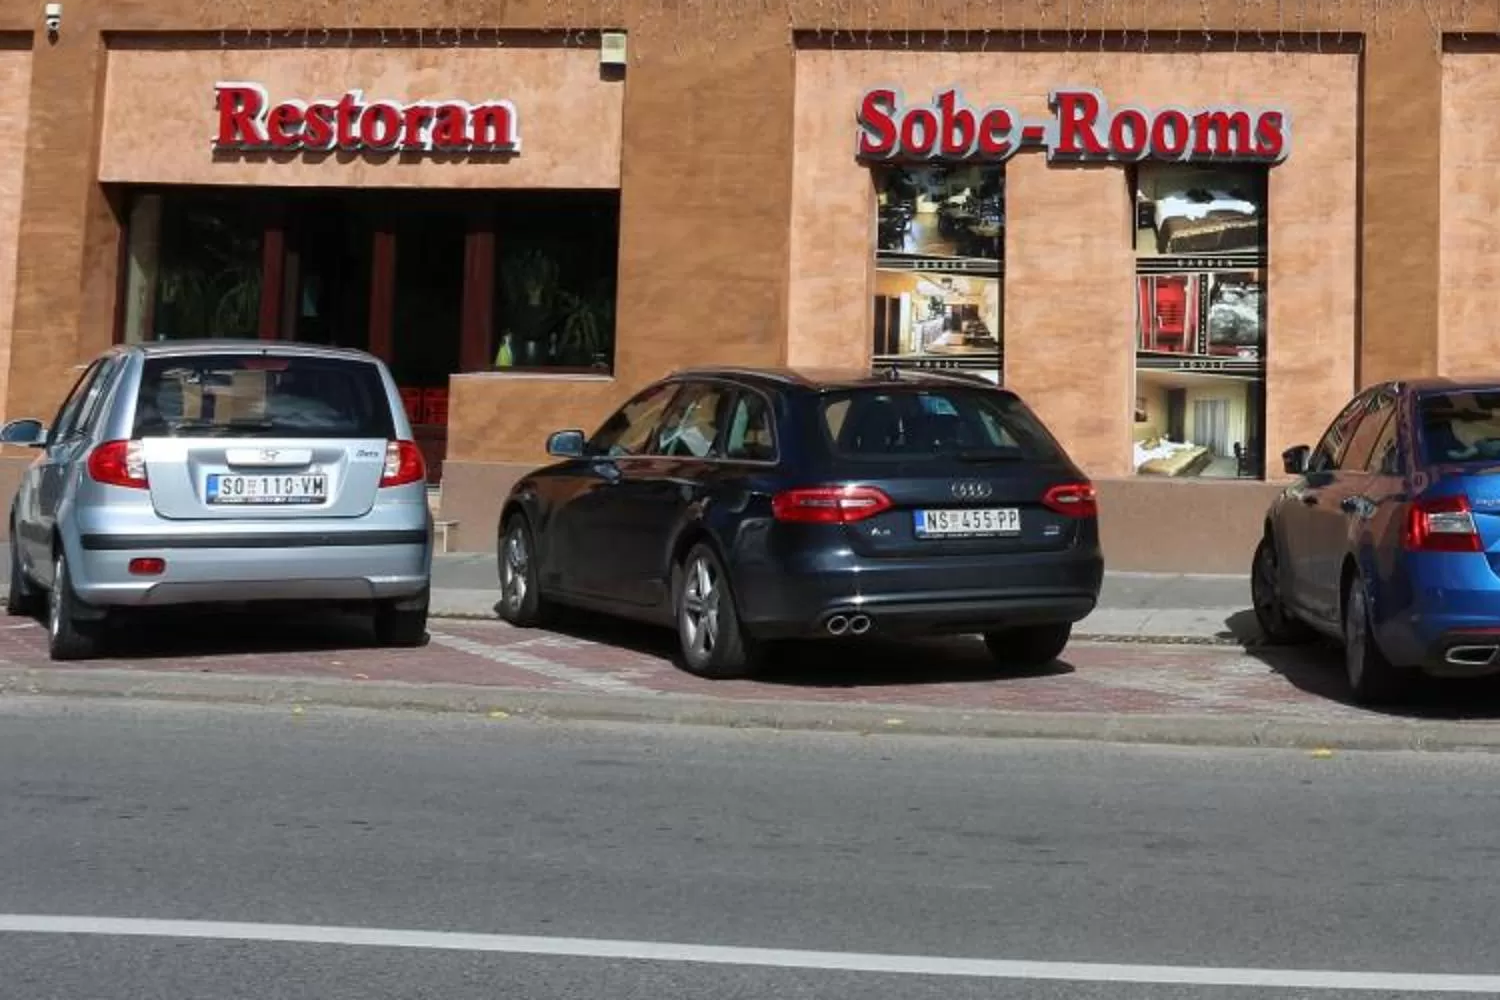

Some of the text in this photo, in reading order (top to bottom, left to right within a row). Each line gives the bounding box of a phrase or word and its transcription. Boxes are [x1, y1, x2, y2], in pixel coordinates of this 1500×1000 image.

[211, 84, 518, 153] Restoran
[223, 477, 245, 495] SO
[927, 511, 949, 529] NS
